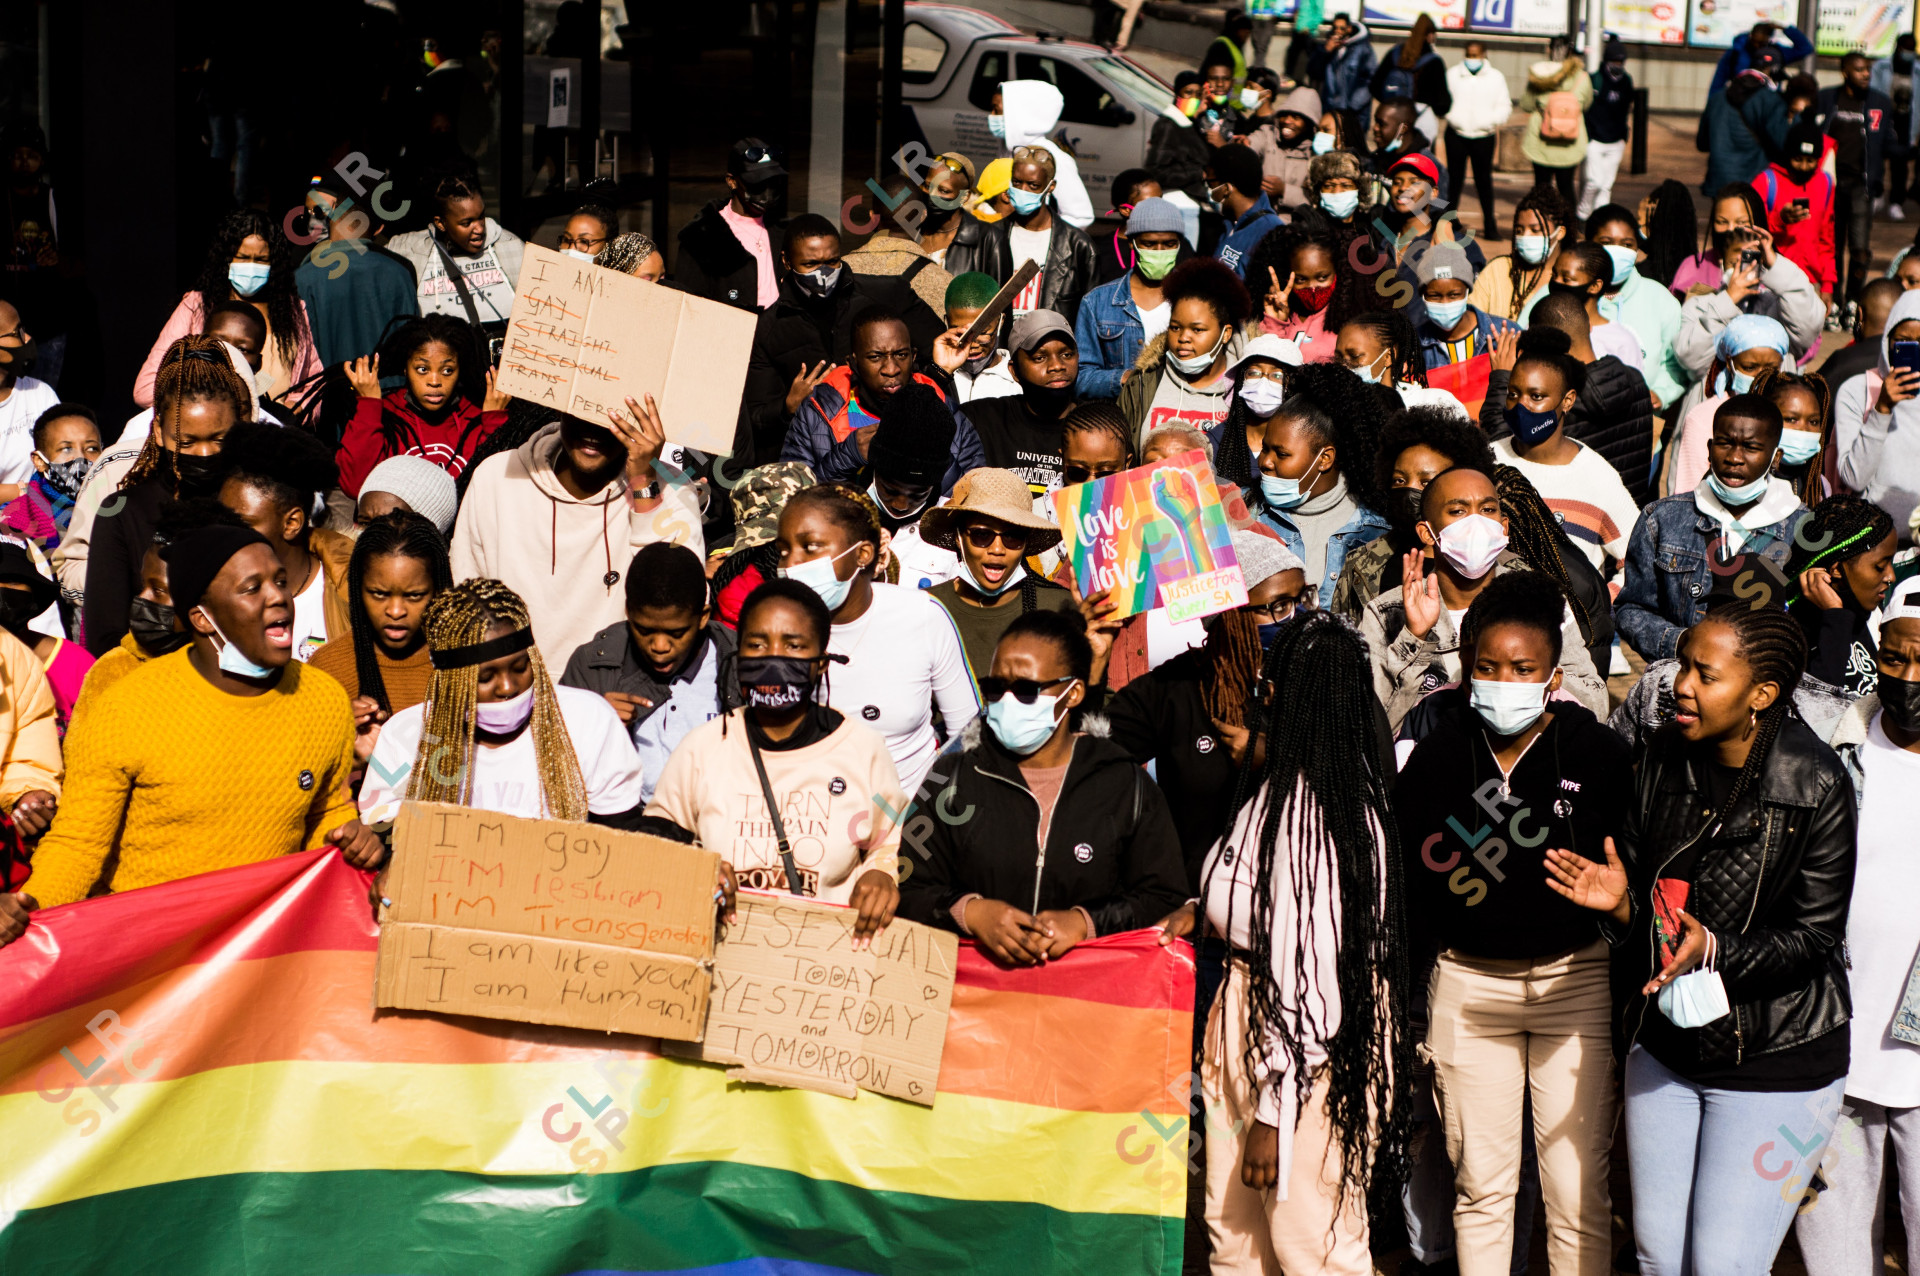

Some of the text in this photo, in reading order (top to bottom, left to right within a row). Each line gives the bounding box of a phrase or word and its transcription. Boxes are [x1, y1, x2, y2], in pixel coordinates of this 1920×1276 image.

[1868, 109, 1882, 131] 7
[531, 258, 559, 283] I
[525, 287, 568, 321] GAY
[514, 319, 613, 353] STRAIGHT
[504, 360, 560, 385] TRANS
[510, 338, 613, 382] BISEXUAL
[1016, 451, 1063, 466] UNIVERSI
[1213, 591, 1234, 606] SA
[468, 941, 533, 964] am
[783, 954, 885, 998] TODAY
[473, 982, 528, 1000] am
[717, 970, 925, 1041] YESTERDAY
[800, 1024, 828, 1037] and
[717, 1024, 892, 1091] TOMORROW
